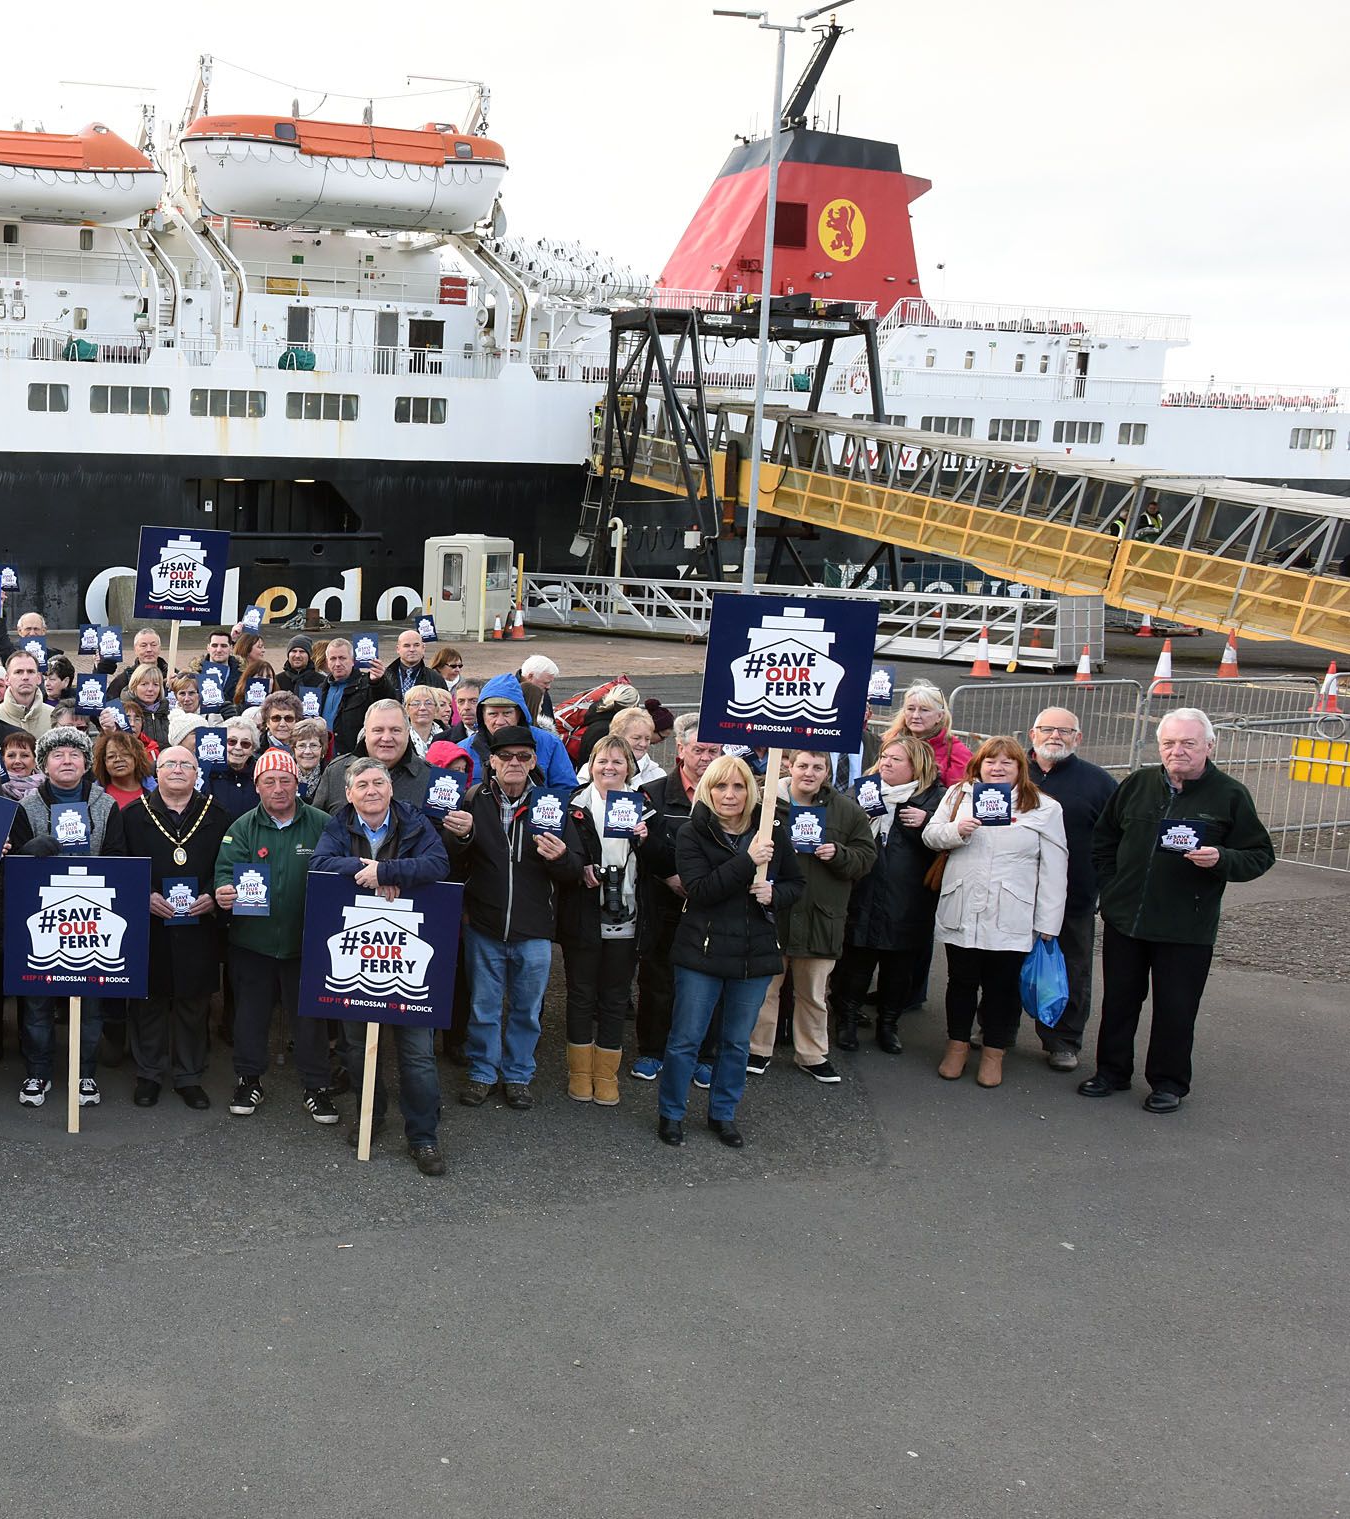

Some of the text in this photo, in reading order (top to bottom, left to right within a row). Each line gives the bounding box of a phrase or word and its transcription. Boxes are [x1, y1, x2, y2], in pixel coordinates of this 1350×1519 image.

[158, 562, 197, 578] #SAVE
[170, 571, 194, 579] OUR
[170, 580, 202, 588] FERRY
[744, 653, 817, 678] #SAVE
[766, 668, 810, 681] OUR
[766, 682, 825, 696] FERRY
[38, 908, 101, 933] #SAVE
[59, 921, 98, 935] OUR
[60, 934, 111, 948] FERRY
[339, 931, 407, 955] #SAVE
[360, 945, 402, 959] OUR
[361, 959, 416, 973] FERRY
